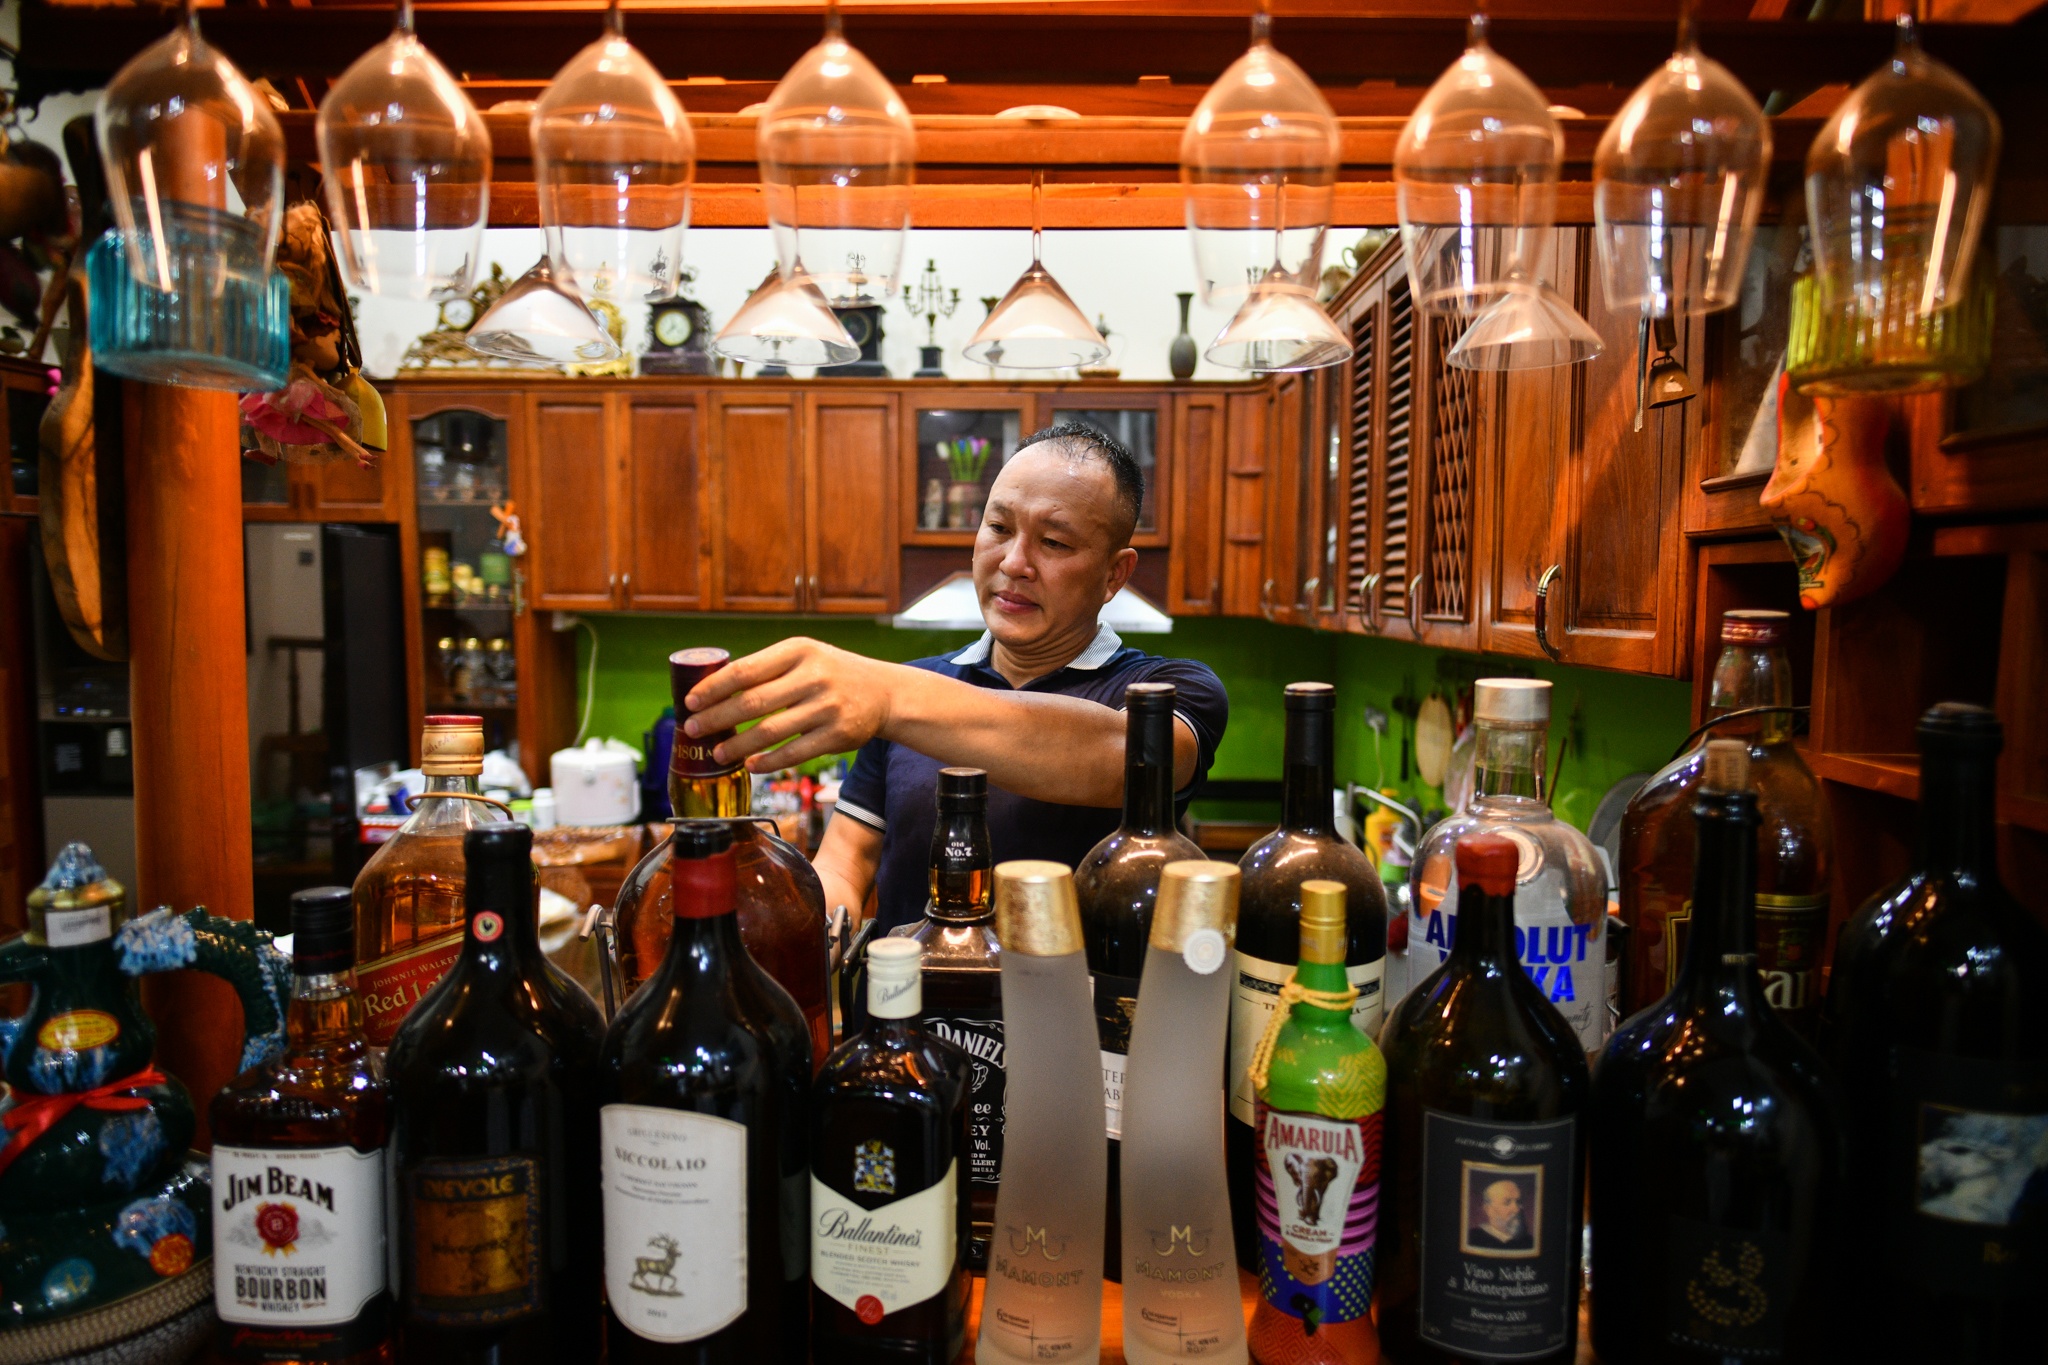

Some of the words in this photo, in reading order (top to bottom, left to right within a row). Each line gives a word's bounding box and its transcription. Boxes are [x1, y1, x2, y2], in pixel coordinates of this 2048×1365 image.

[677, 745, 704, 760] 1801
[945, 847, 972, 857] No.7
[372, 969, 417, 991] JOHNNIE
[363, 985, 410, 1018] Red
[974, 1139, 991, 1151] Vol.
[1267, 1115, 1359, 1164] AMARULA
[223, 1173, 262, 1212] JIM
[266, 1166, 337, 1213] BEAM
[817, 1207, 922, 1248] Ballantine's
[1292, 1224, 1327, 1237] CREAM
[820, 1250, 854, 1261] BLENDED
[857, 1255, 888, 1265] SCOTCH
[890, 1259, 921, 1268] WHISKY
[847, 1243, 890, 1256] FINEST
[234, 1263, 279, 1276] KENTUCKY
[281, 1264, 326, 1277] STRAIGHT
[995, 1255, 1084, 1287] MAMONT
[1135, 1257, 1225, 1283] MAMONT
[1463, 1261, 1494, 1280] Vino
[1499, 1264, 1537, 1281] Nobile
[235, 1275, 327, 1300] BOURBON
[260, 1301, 300, 1313] WHISKEY
